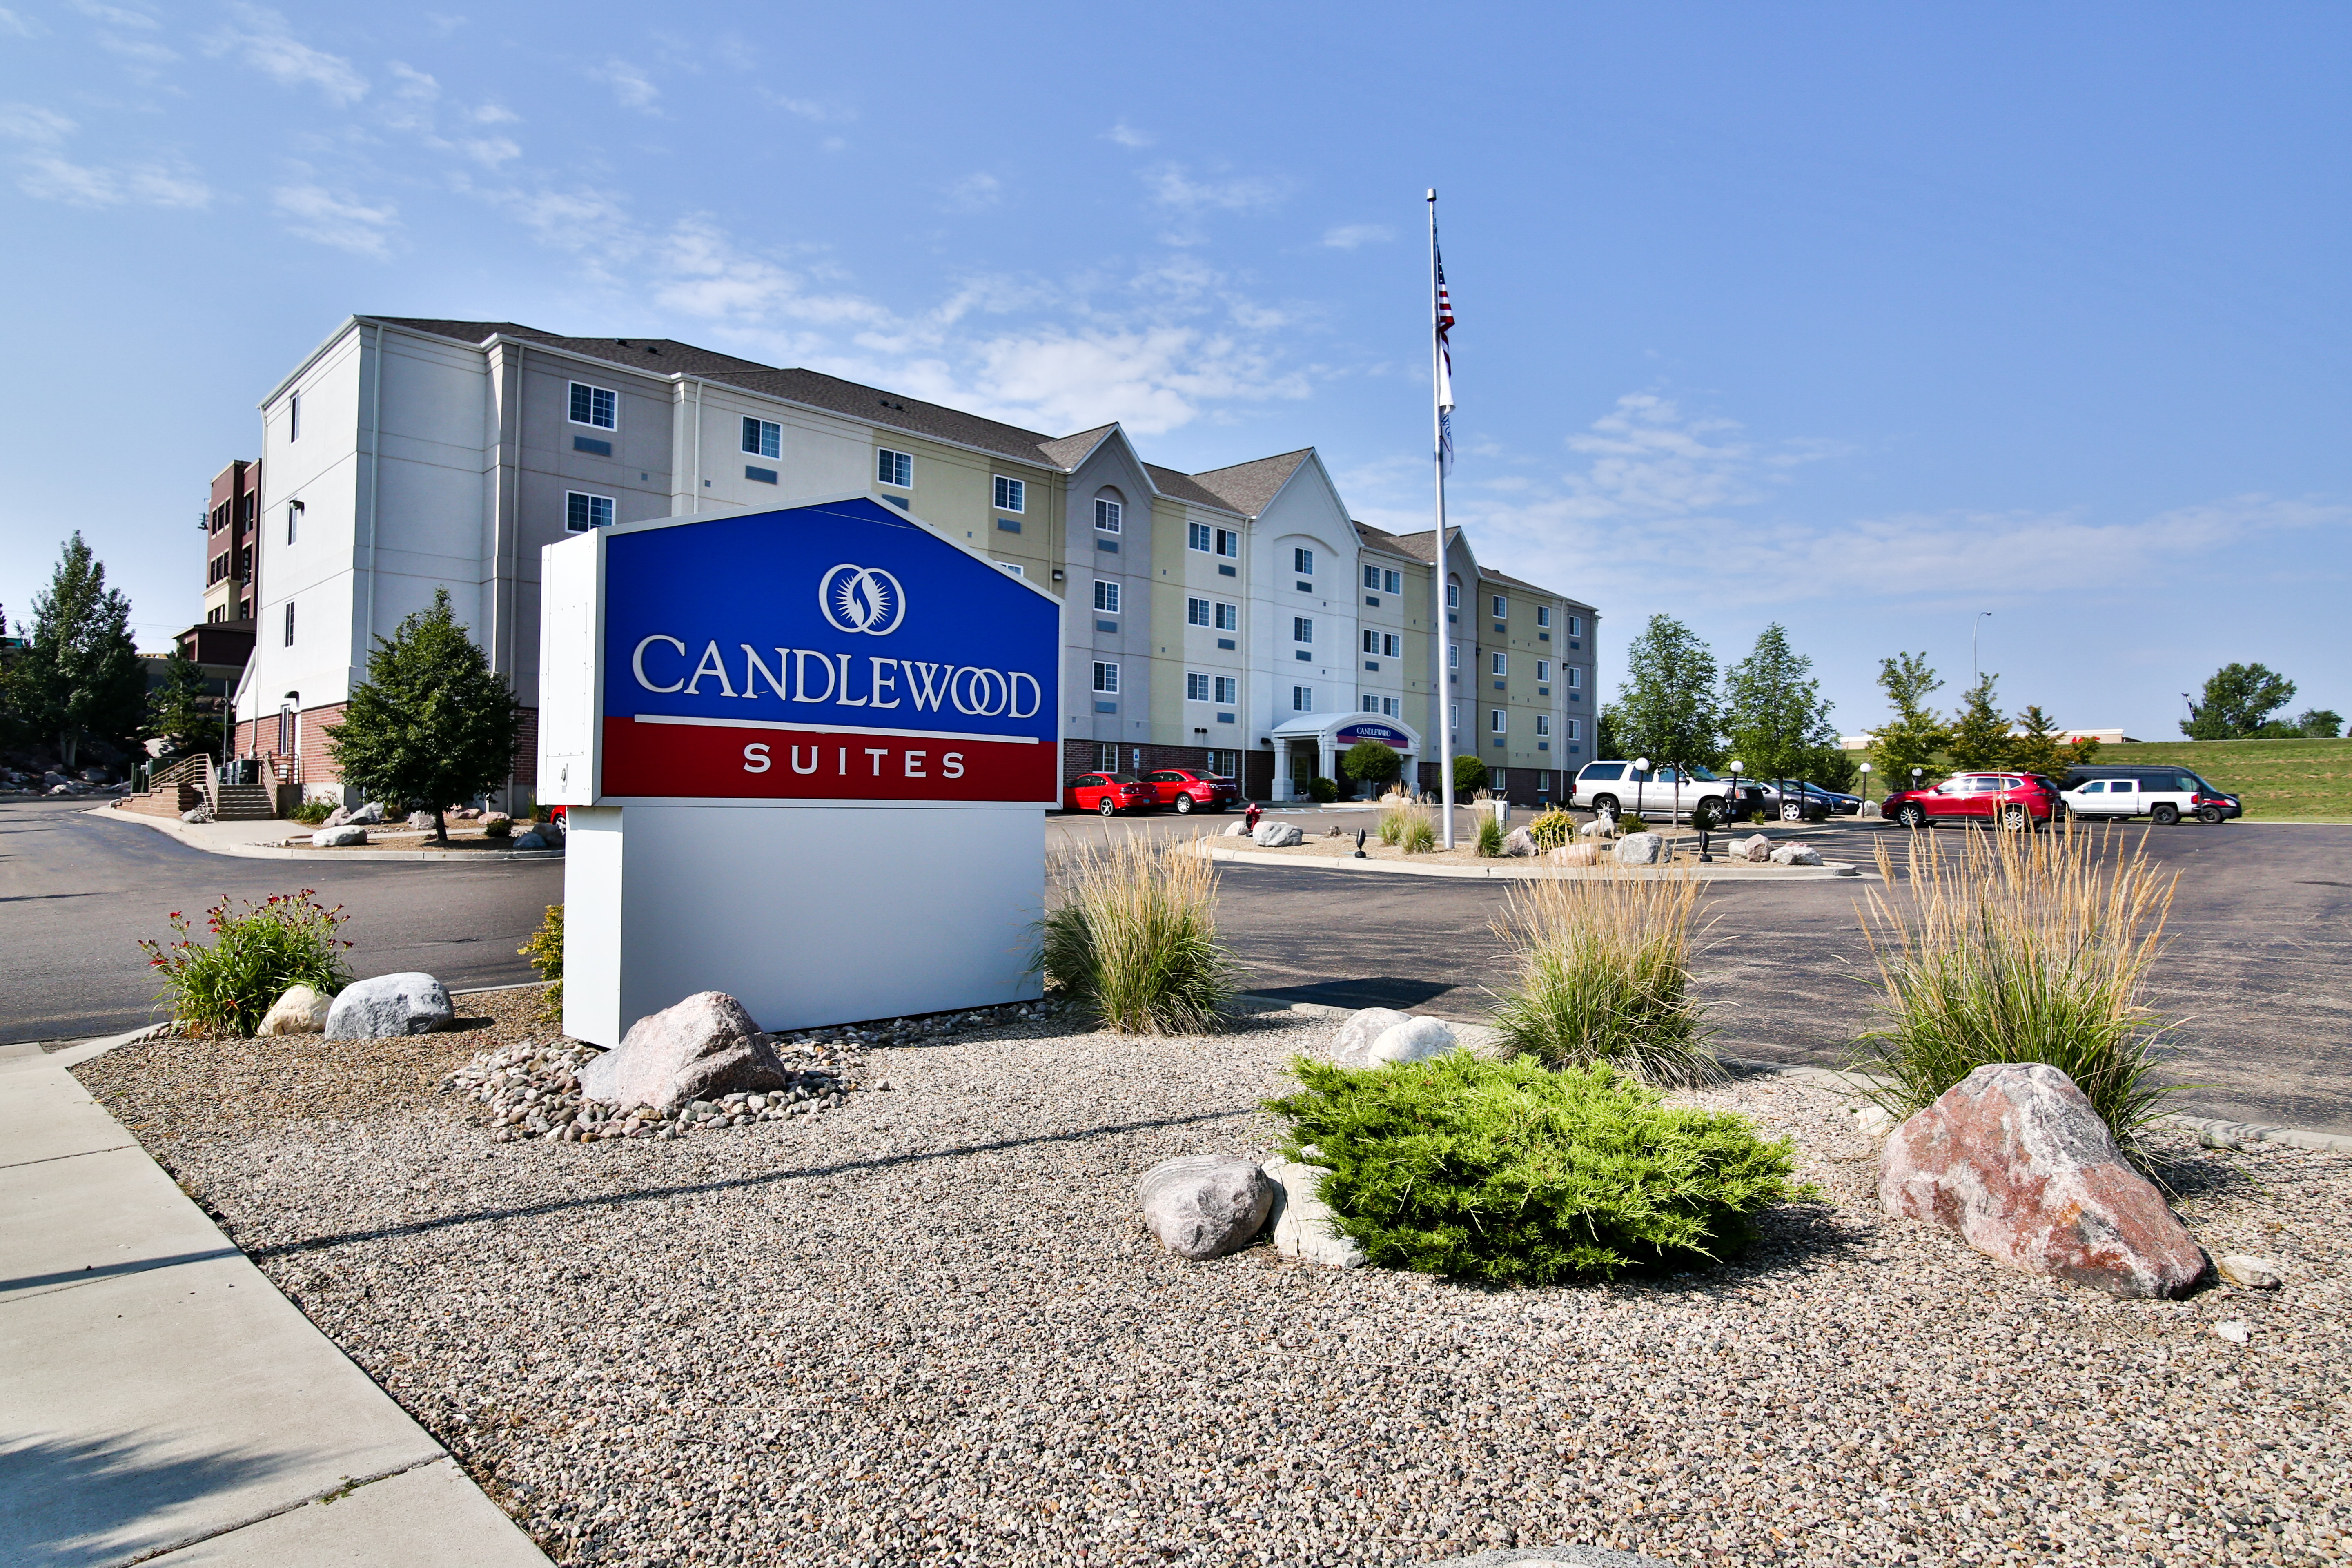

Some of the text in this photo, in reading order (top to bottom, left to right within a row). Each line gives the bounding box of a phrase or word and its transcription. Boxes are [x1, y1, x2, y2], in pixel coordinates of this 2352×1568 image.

[632, 635, 1042, 718] CANDLEWOOD
[1356, 727, 1391, 737] CANDLEWOOD
[743, 742, 964, 779] SUITES
